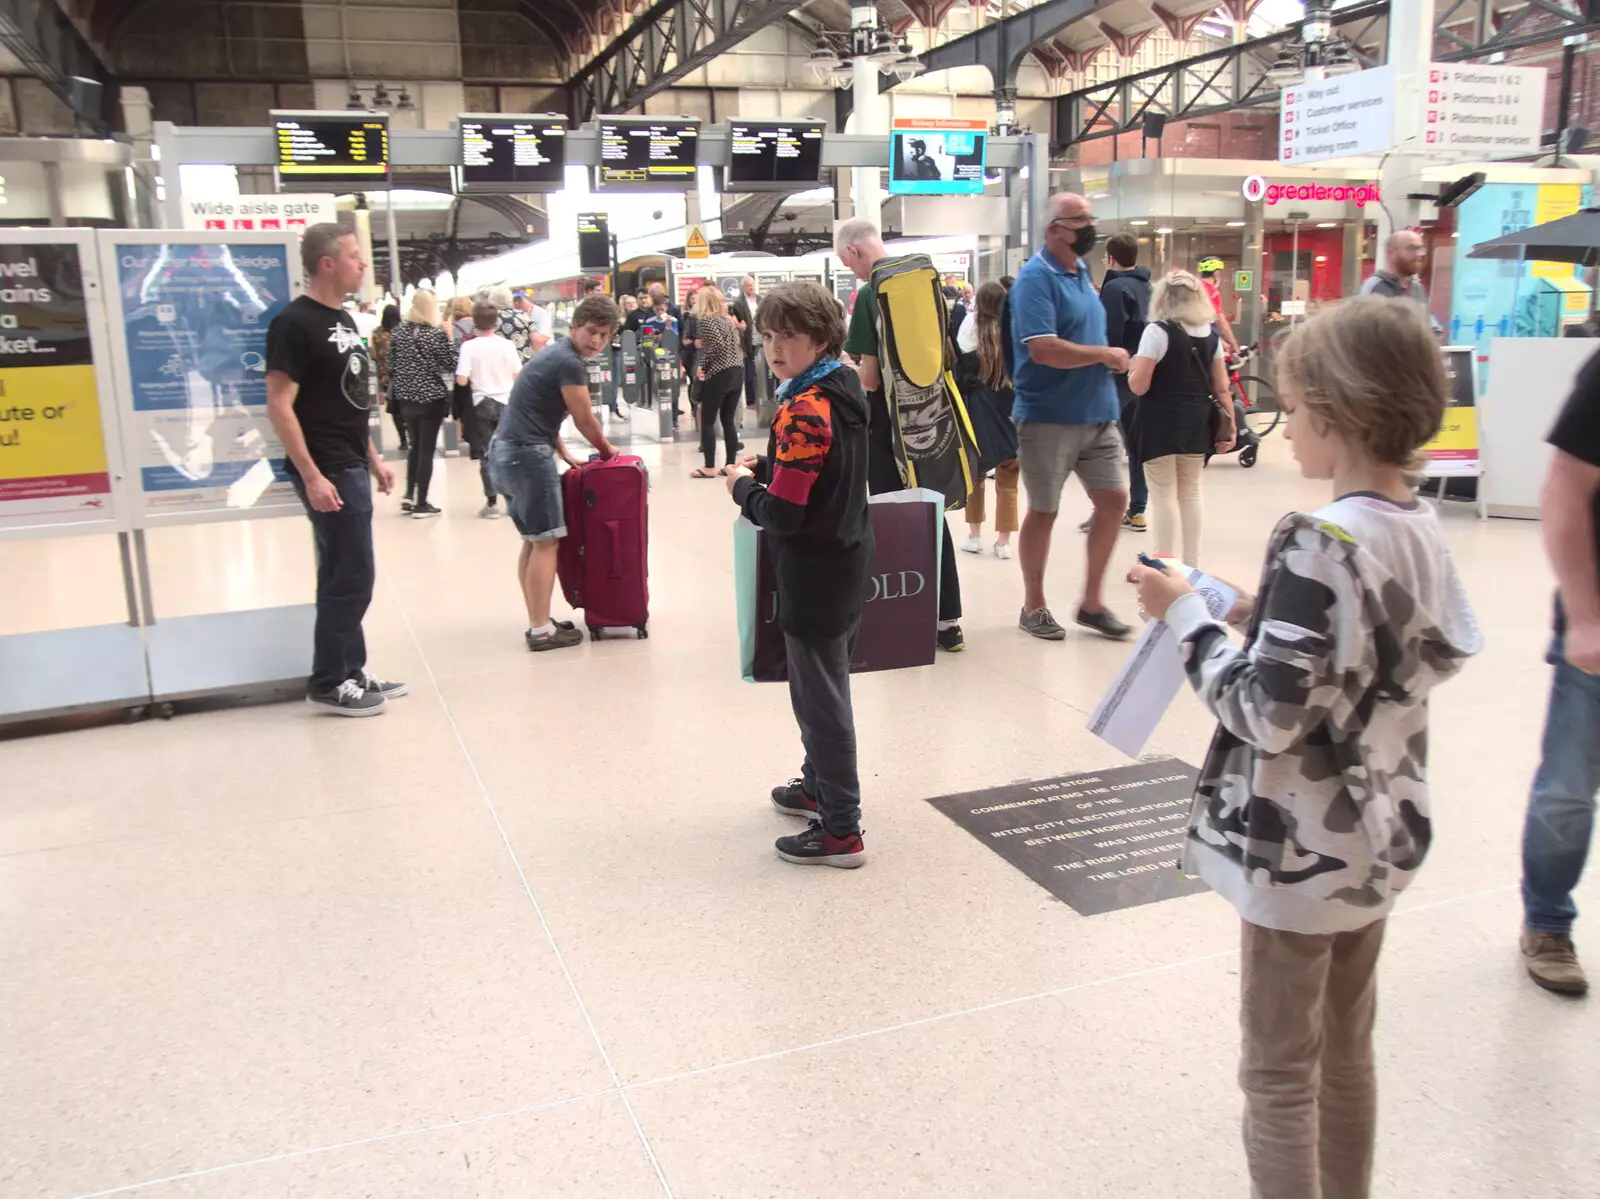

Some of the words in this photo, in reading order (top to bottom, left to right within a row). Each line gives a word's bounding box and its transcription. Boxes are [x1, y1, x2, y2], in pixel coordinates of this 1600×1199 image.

[1454, 72, 1497, 84] Platforms
[1506, 75, 1513, 84] &
[1515, 75, 1521, 85] 2
[1307, 89, 1324, 100] Way
[1326, 85, 1340, 96] out
[1453, 92, 1496, 104] Platforms
[1306, 104, 1346, 118] Customer
[1347, 96, 1383, 110] services
[1451, 112, 1494, 124] Platforms
[1306, 125, 1331, 136] Ticket
[1332, 120, 1358, 132] Office
[1450, 132, 1494, 144] Customer
[1494, 136, 1530, 145] services
[1305, 144, 1335, 154] Waiting
[1336, 140, 1359, 150] room
[190, 202, 234, 215] Wide
[239, 202, 278, 215] aisle
[283, 202, 320, 217] gate
[0, 257, 38, 277] vel
[121, 255, 148, 268] Our
[42, 406, 66, 419] or
[1029, 783, 1060, 792] THIS
[1061, 776, 1103, 788] STONE
[970, 791, 1084, 814] COMMEMORATING
[1083, 787, 1111, 796] THE
[1111, 774, 1188, 791] COMPLETION
[1096, 797, 1123, 806] THE
[990, 826, 1034, 838] INTER
[1034, 820, 1065, 830] CITY
[1067, 801, 1177, 825] ELECTRIFICATION
[1024, 829, 1094, 846] BETWEEN
[1092, 818, 1157, 834] NORWICH
[1158, 812, 1185, 822] AND
[1093, 838, 1127, 848] WAS
[1053, 861, 1085, 871] THE
[1085, 853, 1128, 866] RIGHT
[1086, 871, 1118, 881] THE
[1117, 863, 1159, 876] LORD
